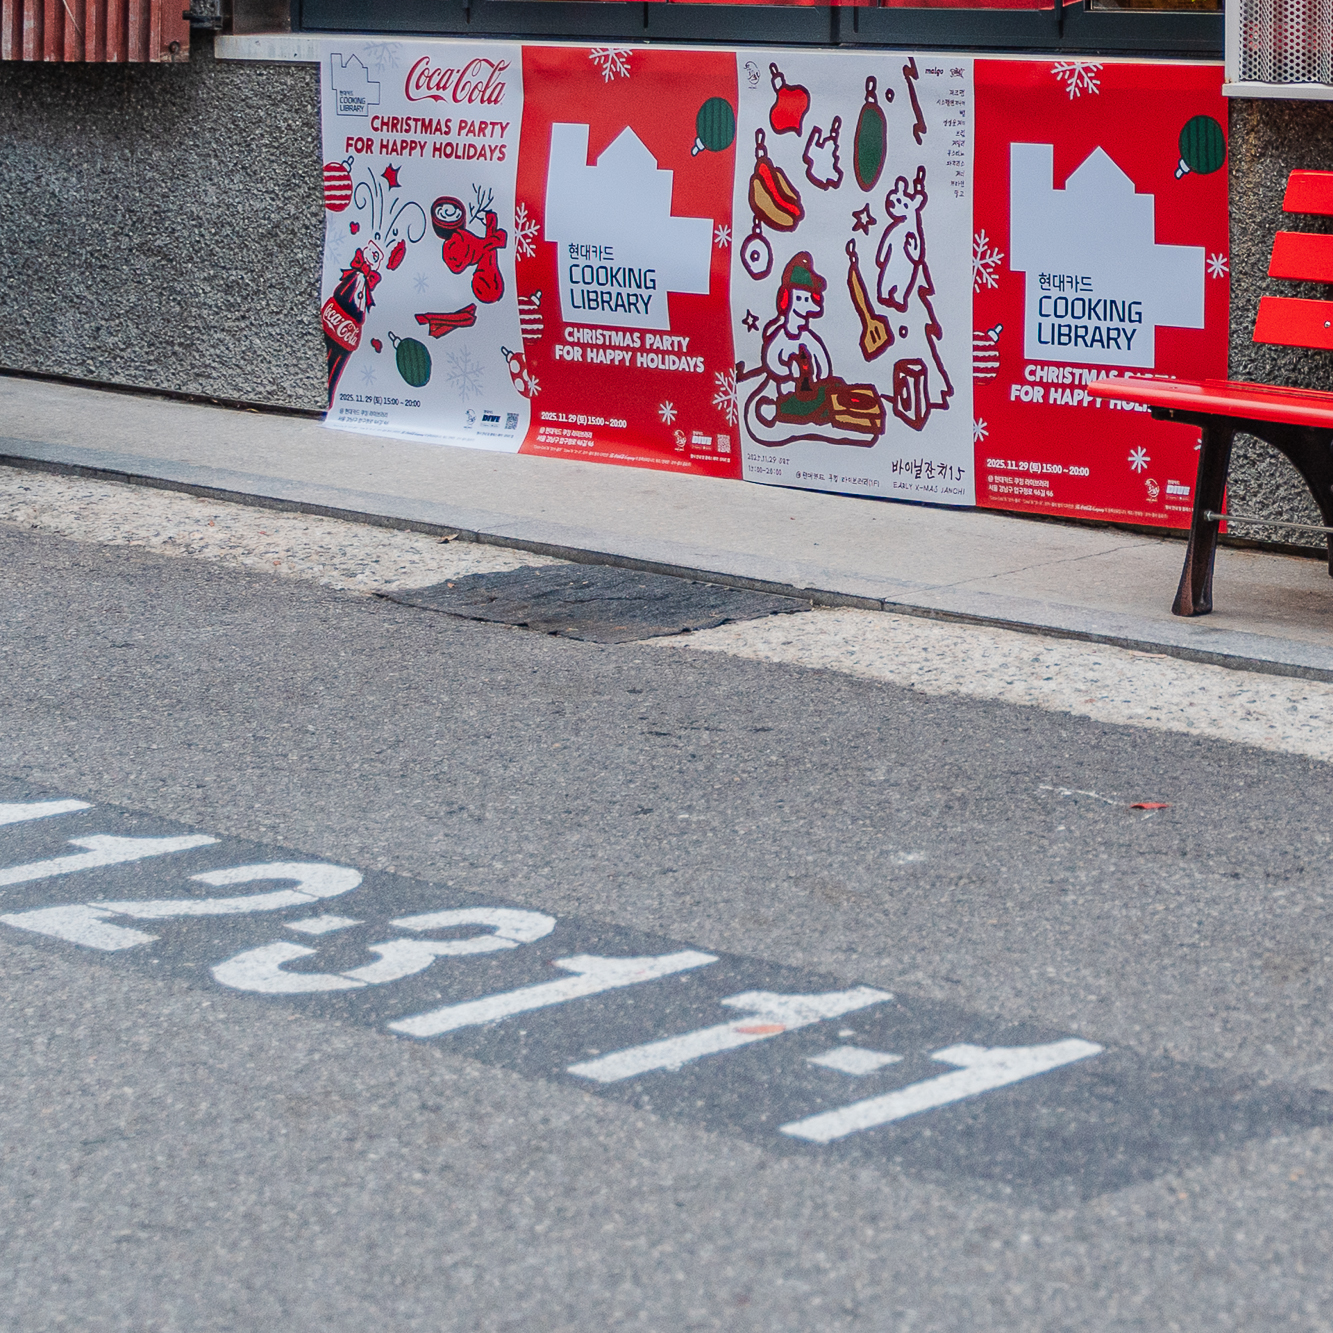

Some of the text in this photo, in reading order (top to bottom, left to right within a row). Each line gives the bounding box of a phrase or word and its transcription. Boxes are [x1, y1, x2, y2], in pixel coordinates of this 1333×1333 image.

[404, 55, 512, 106] Coca-Cola
[339, 97, 366, 105] COOKING
[339, 104, 365, 113] LIBRARY
[370, 115, 510, 139] CHRISTMAS PARTY
[345, 136, 507, 162] FOR HAPPY HOLIDAYS
[568, 242, 614, 261] 현대카드
[569, 264, 656, 290] COOKING
[1038, 272, 1093, 293] 현대카드
[570, 288, 652, 315] LIBRARY
[1038, 295, 1143, 324] COOKING
[564, 327, 690, 352] CHRISTMAS PARTY
[1037, 322, 1137, 350] LIBRARY
[555, 344, 705, 373] FOR HAPPY HOLIDAYS
[1024, 364, 1118, 385] CHRISTMAS
[1010, 384, 1044, 402] FOR
[987, 458, 1006, 468] 2025.
[1007, 460, 1018, 469] 11.
[1019, 461, 1028, 471] 29
[1042, 463, 1062, 474] 15:00
[1069, 466, 1090, 476] 20:00
[893, 481, 913, 490] EARLY
